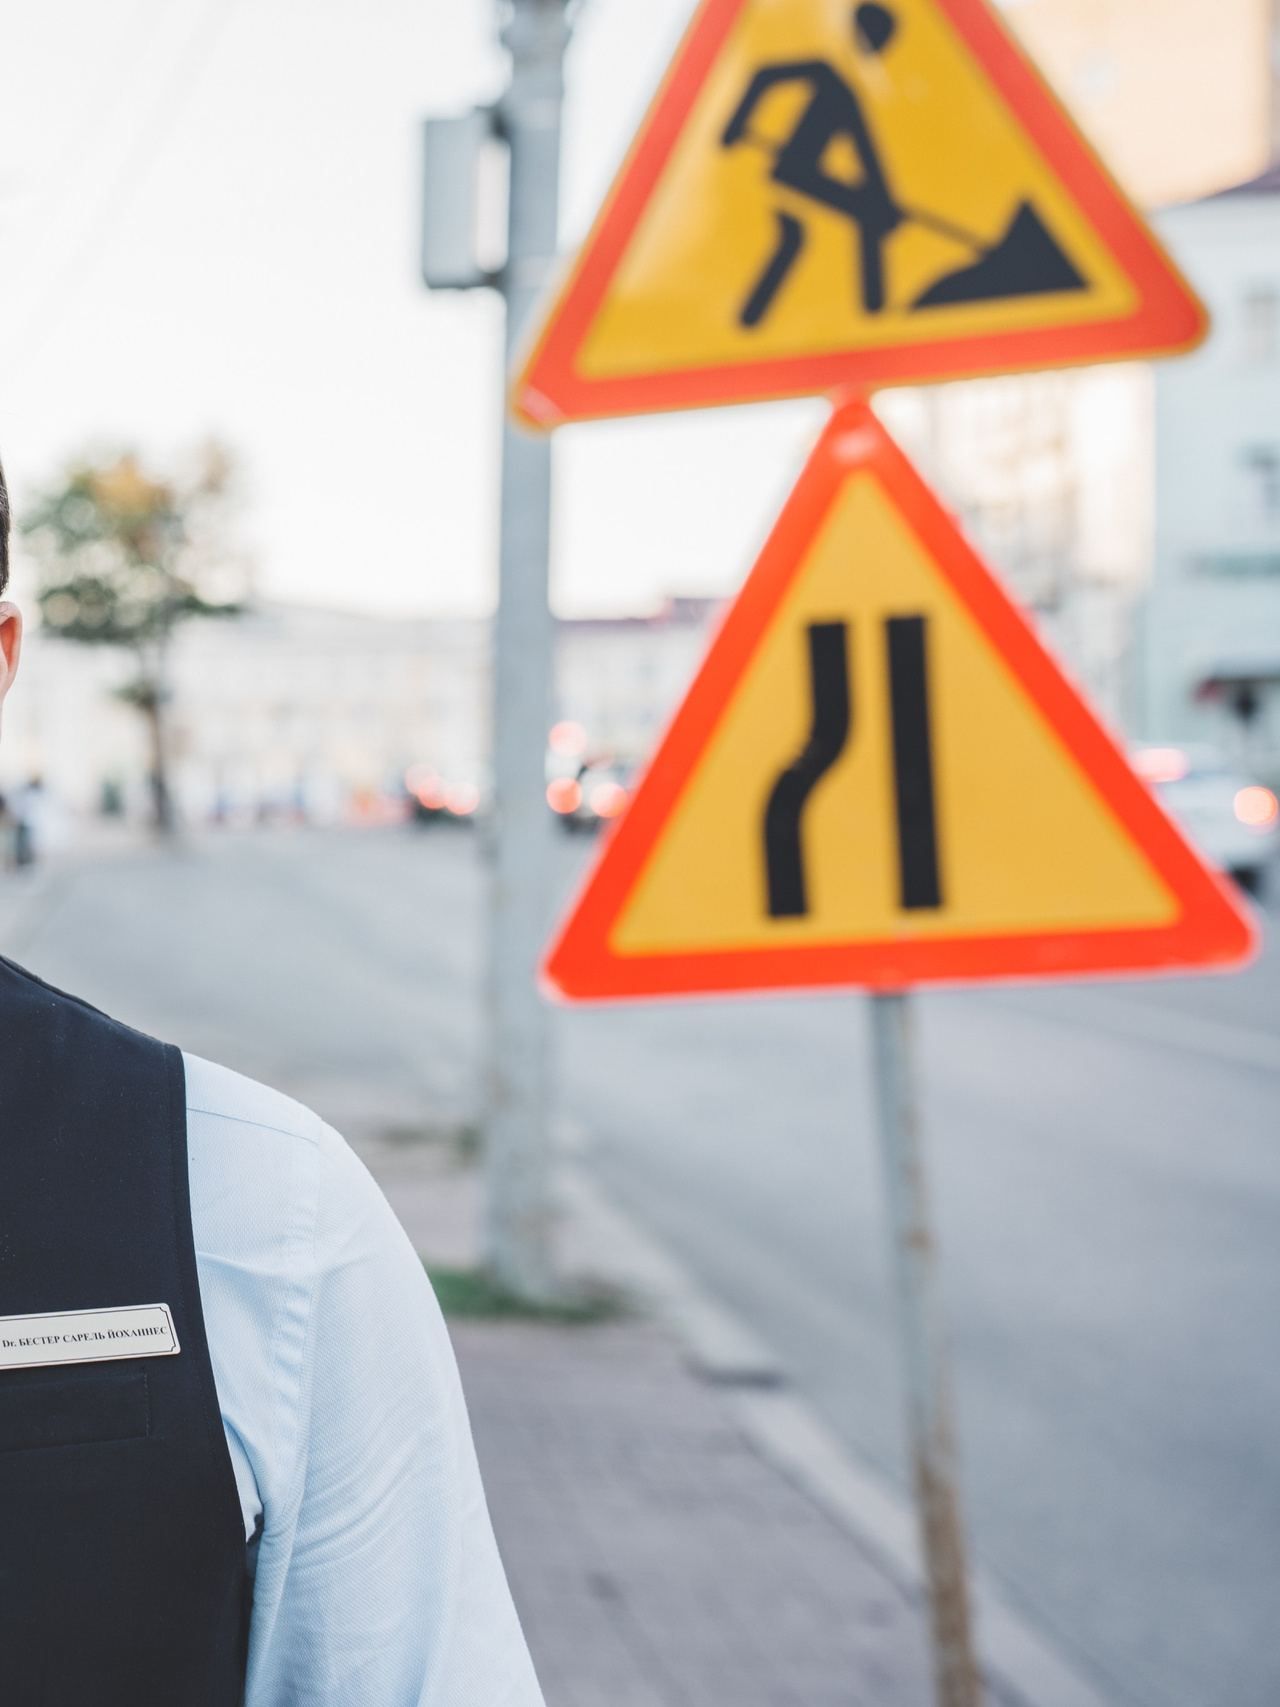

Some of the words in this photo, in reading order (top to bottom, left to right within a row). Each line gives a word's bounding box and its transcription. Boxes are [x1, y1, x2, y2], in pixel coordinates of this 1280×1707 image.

[2, 1339, 17, 1348] Dr.
[19, 1335, 60, 1347] БЕСТЕР
[62, 1332, 106, 1343] САРЕЛЬ
[107, 1326, 168, 1339] ЙОХАННЕС
